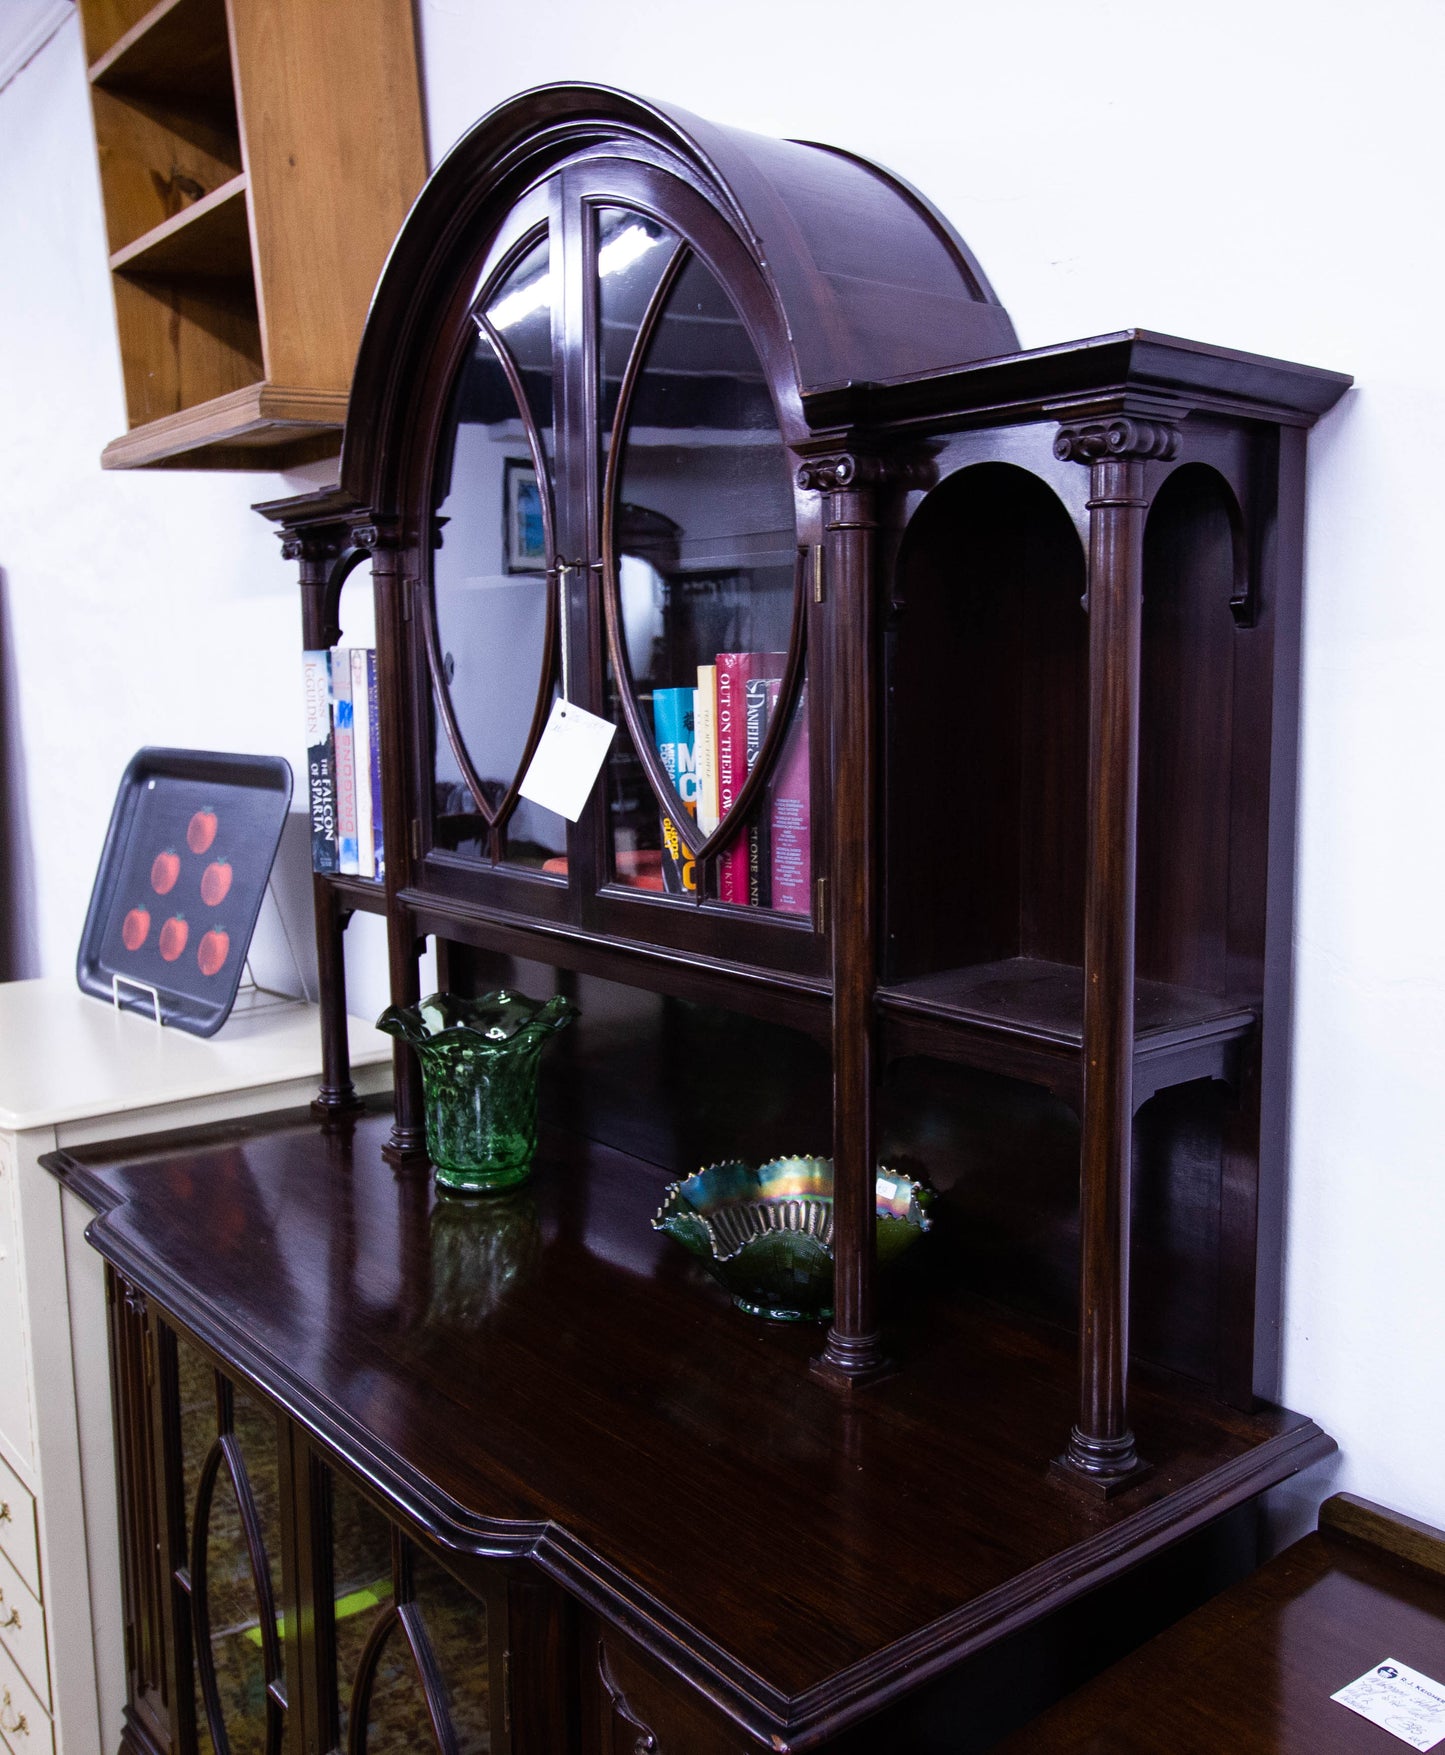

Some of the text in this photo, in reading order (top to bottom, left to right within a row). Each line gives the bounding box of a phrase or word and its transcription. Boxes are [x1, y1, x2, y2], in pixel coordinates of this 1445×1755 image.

[305, 663, 318, 734] IGGULDEN
[720, 673, 731, 710] OUT
[721, 710, 731, 732] ON
[746, 693, 765, 748] DANIELLE
[722, 736, 732, 785] THEIR
[311, 763, 324, 833] OF SPARTA
[322, 779, 334, 841] FALCON
[751, 876, 759, 907] AND
